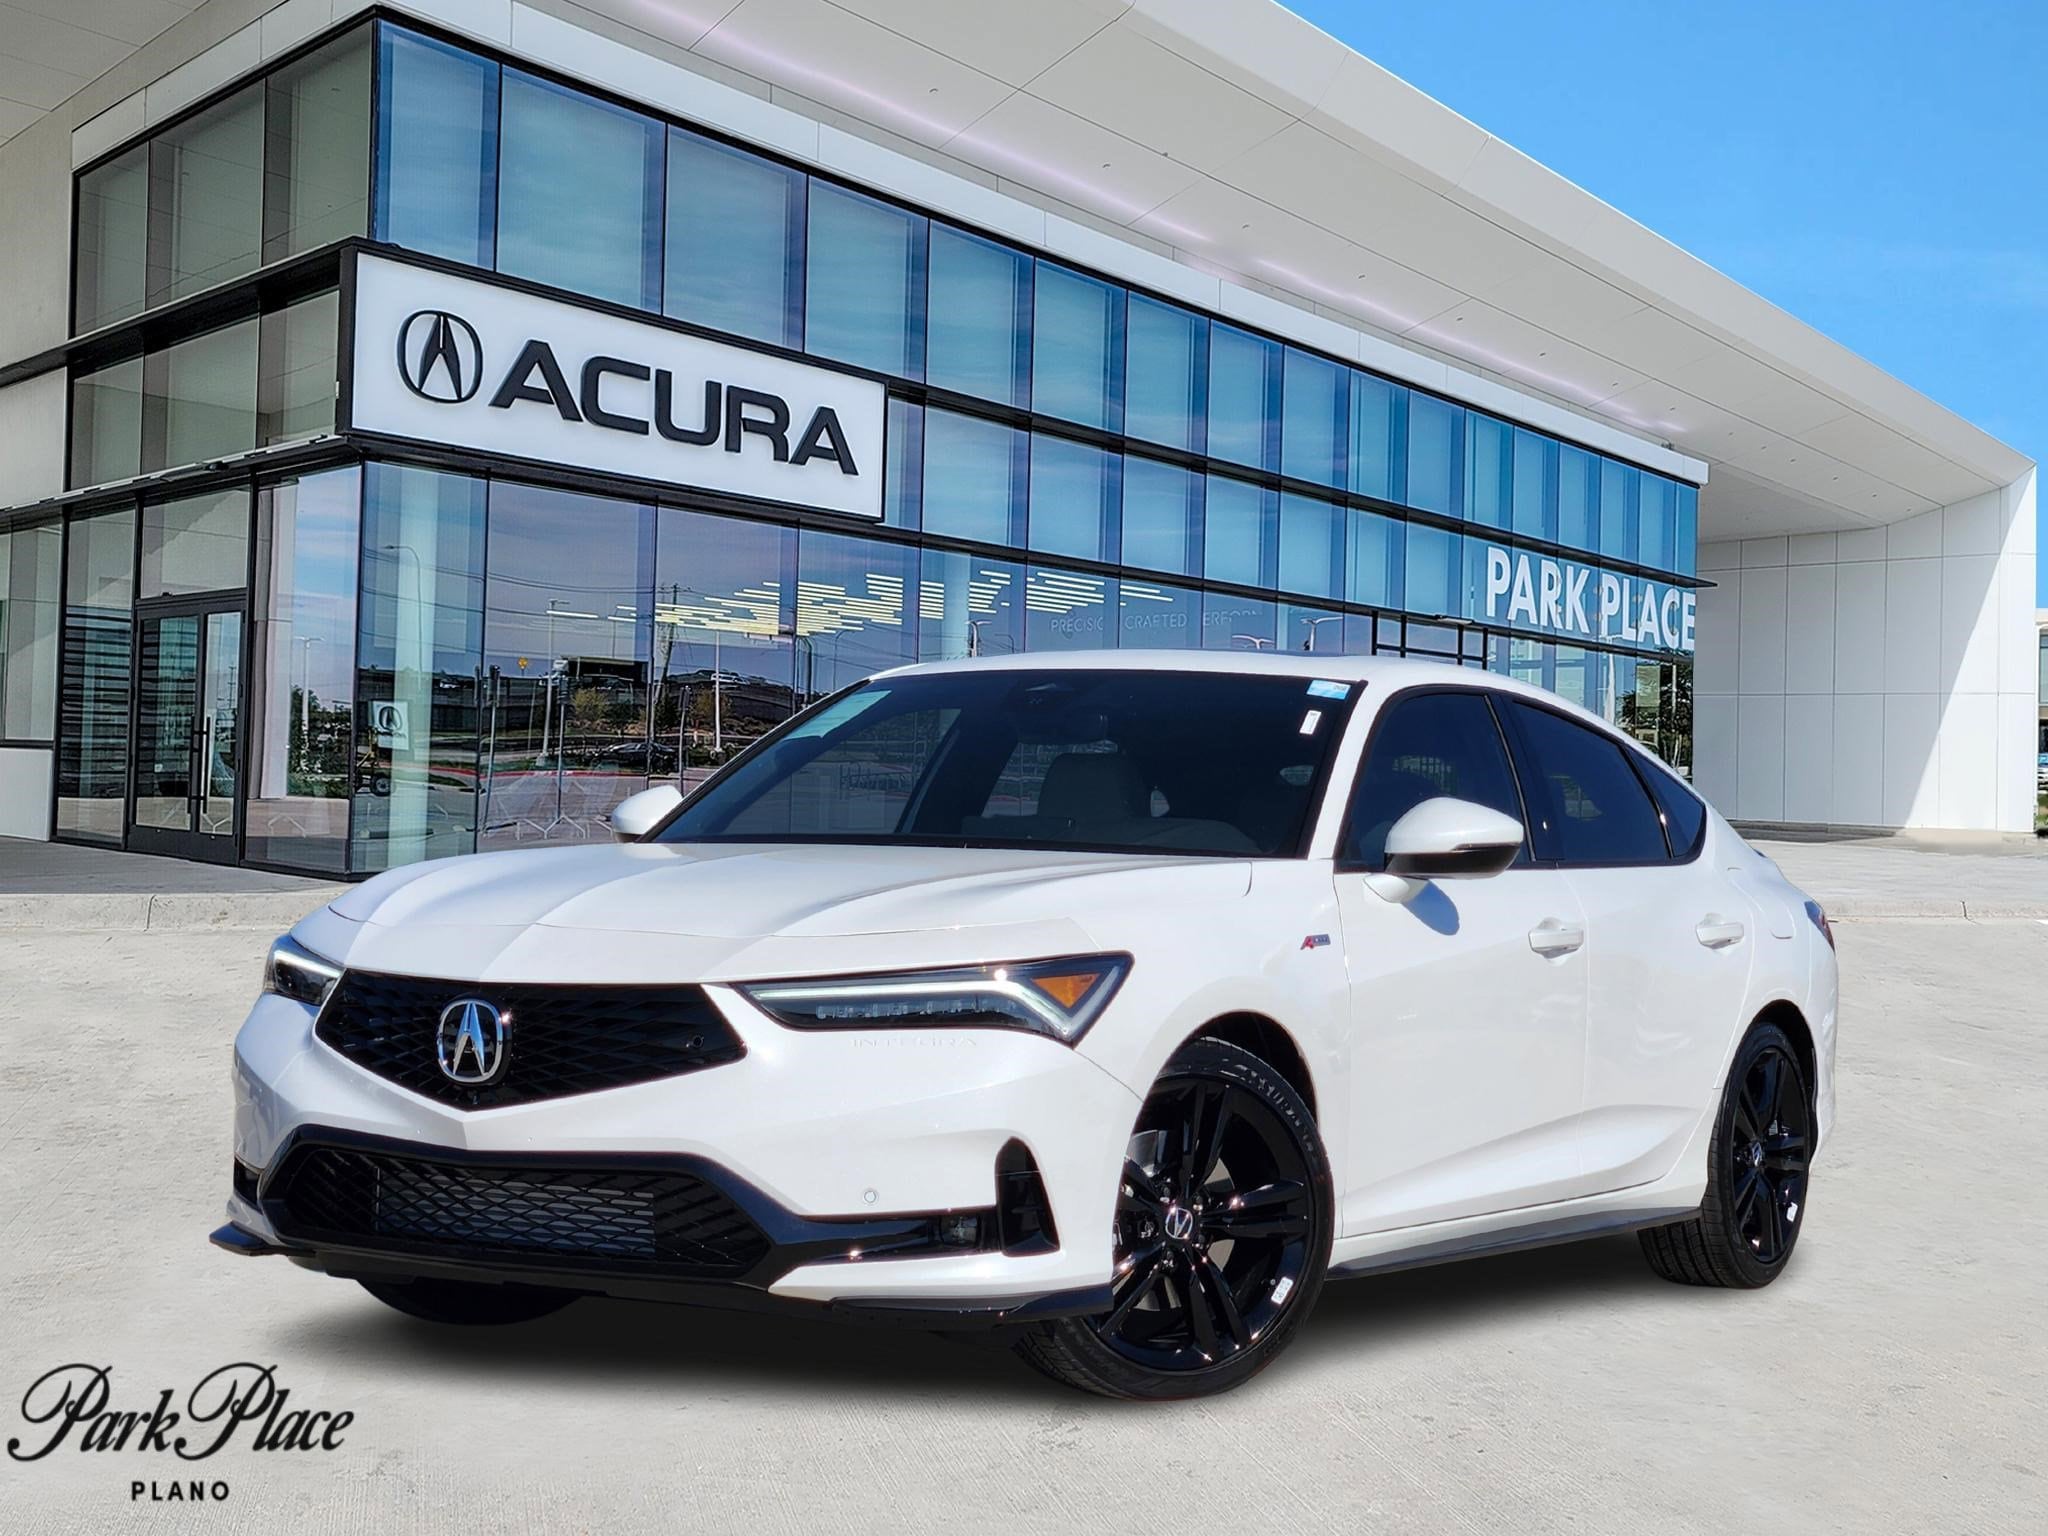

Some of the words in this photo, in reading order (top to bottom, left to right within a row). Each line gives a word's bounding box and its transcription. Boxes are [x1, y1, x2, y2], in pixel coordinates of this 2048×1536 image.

[489, 339, 860, 477] ACURA
[1486, 546, 1590, 634] PARK
[1601, 573, 1696, 650] PLACE
